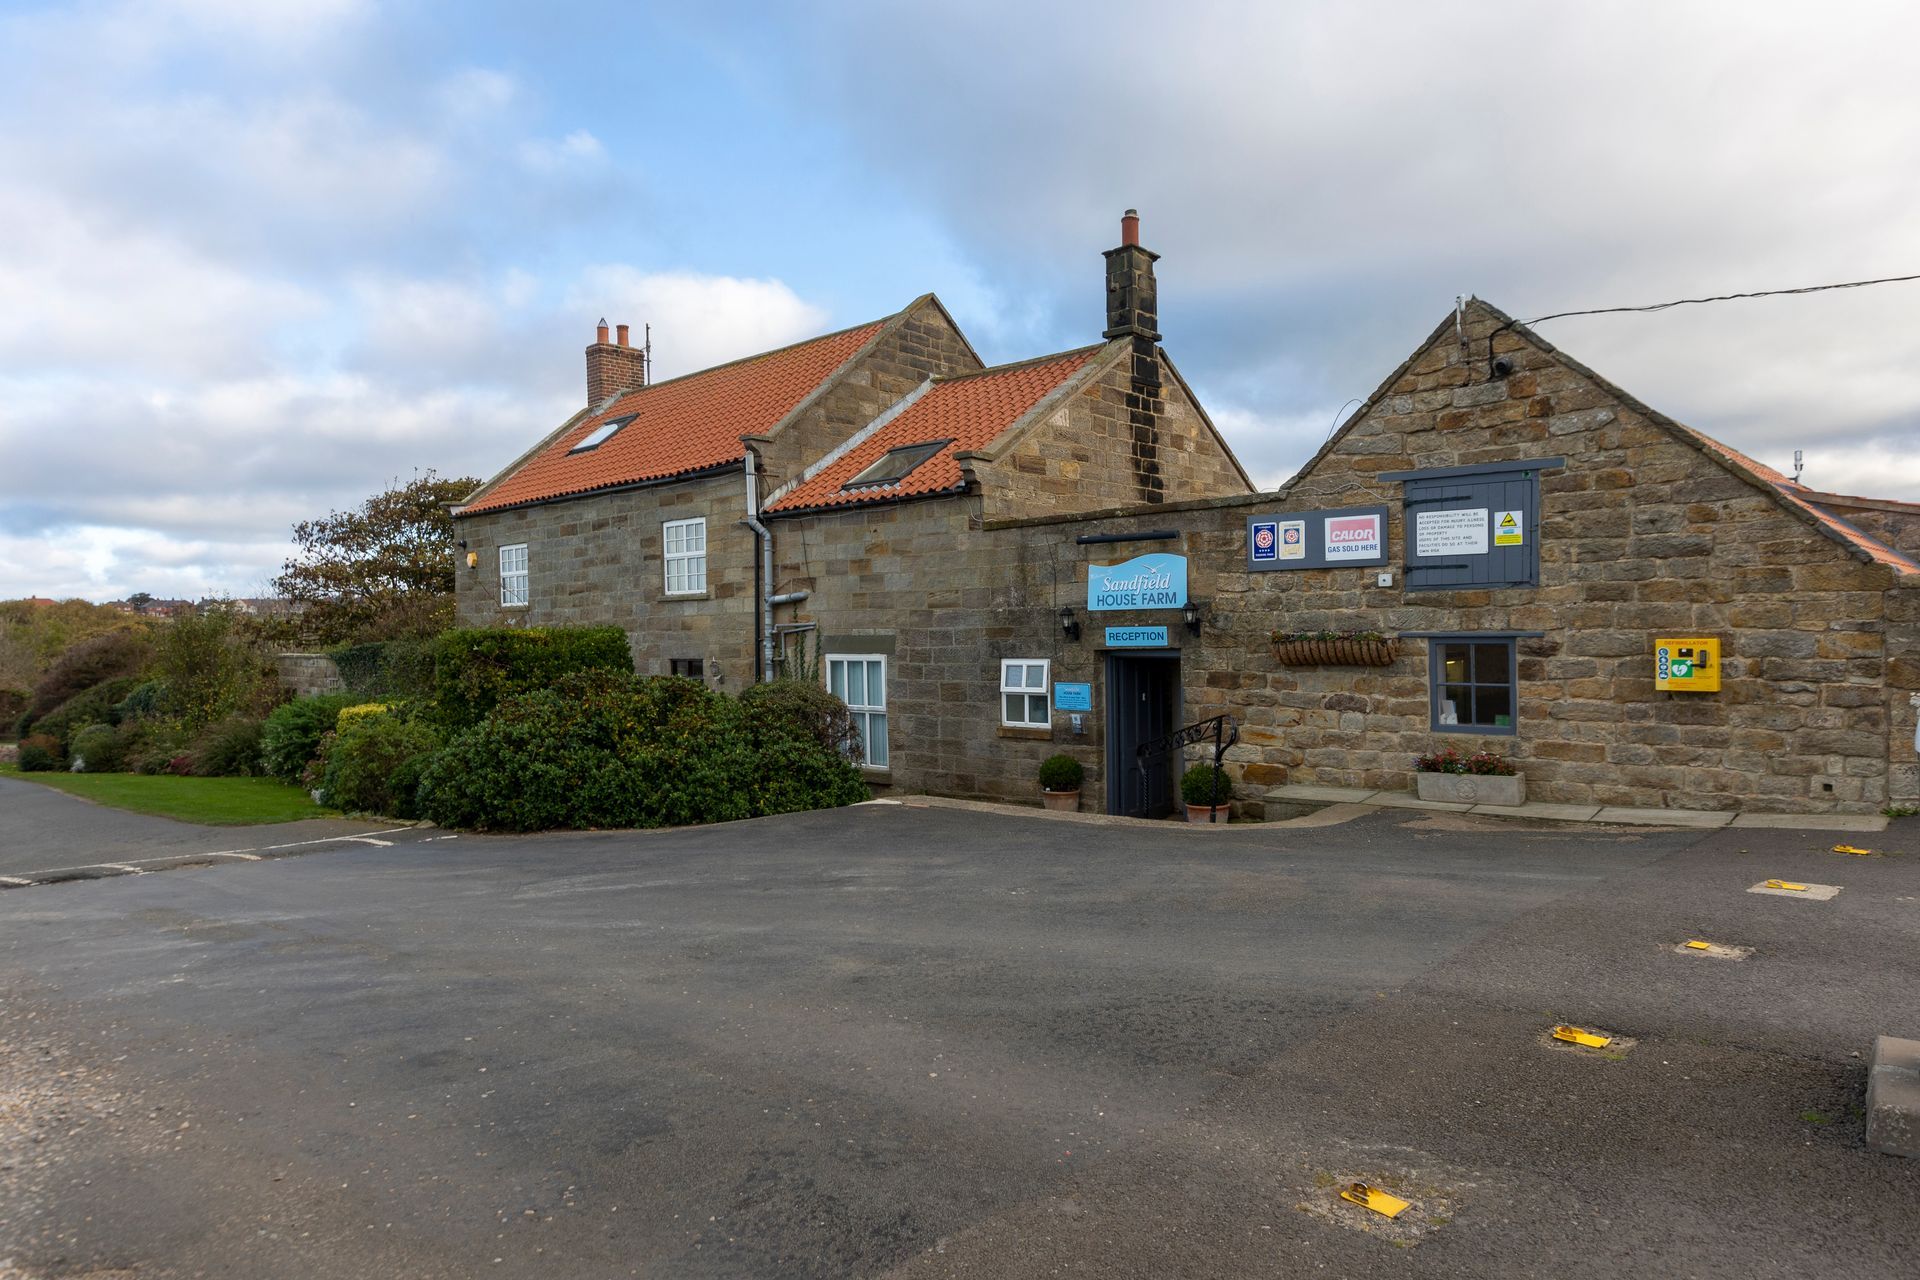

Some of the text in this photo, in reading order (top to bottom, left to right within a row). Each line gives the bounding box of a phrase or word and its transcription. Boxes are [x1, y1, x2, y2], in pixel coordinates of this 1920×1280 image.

[1332, 529, 1374, 541] CALOR
[1102, 573, 1171, 595] Sandfield
[1097, 592, 1176, 606] HOUSE FARM
[1109, 632, 1164, 641] RECEPTION
